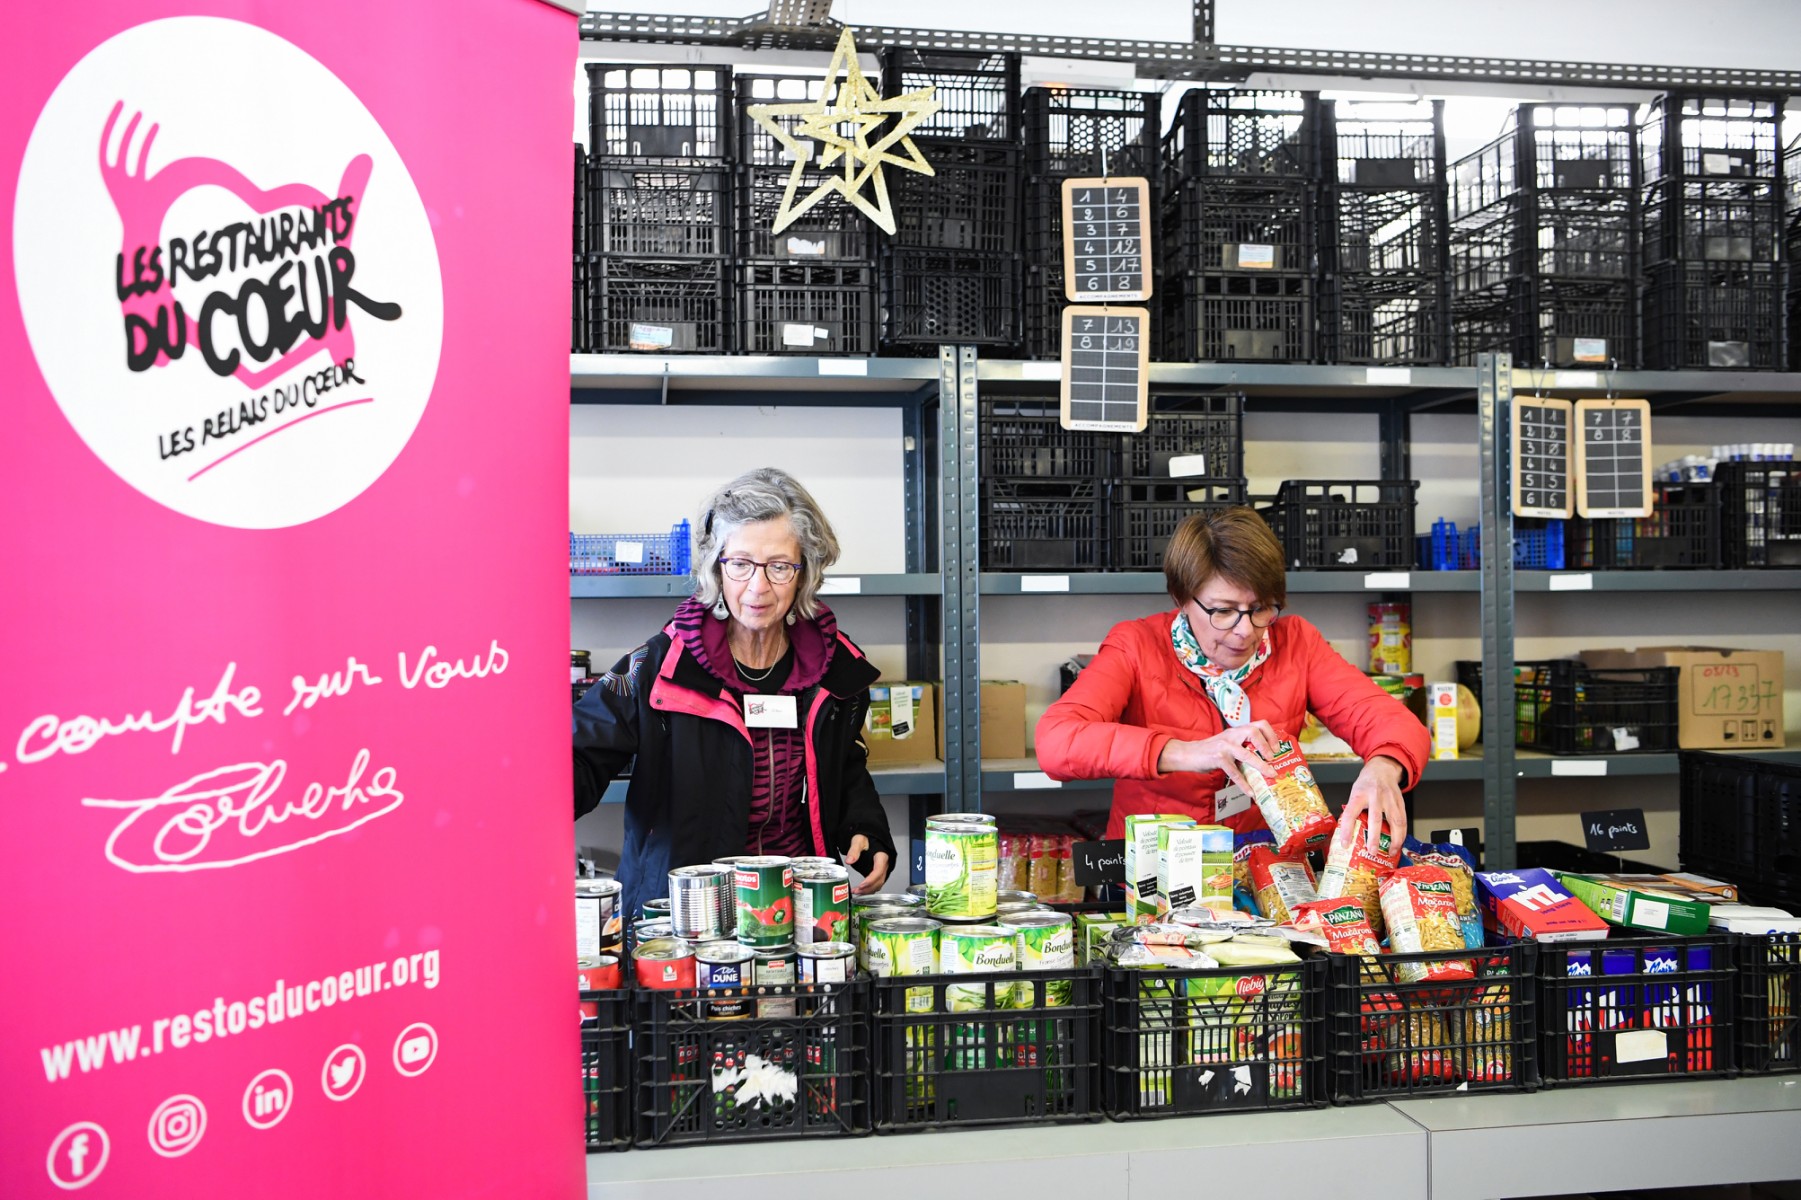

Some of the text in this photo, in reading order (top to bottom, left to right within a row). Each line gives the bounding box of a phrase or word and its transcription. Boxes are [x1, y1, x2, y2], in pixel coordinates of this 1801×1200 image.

[1079, 188, 1127, 204] 1 4
[1084, 203, 1128, 221] 2 6
[1086, 223, 1129, 236] 3 7
[116, 196, 354, 302] LES RESTAURANTS
[1084, 238, 1137, 255] 4 12
[1085, 257, 1140, 273] 5 17
[1087, 275, 1131, 290] 6 8
[1082, 319, 1135, 335] 7 13
[124, 301, 187, 373] DU
[1080, 335, 1135, 351] 8 19
[158, 431, 195, 461] LES
[201, 393, 270, 446] RELAIS
[273, 382, 299, 411] DU
[1527, 442, 1536, 454] 3
[1525, 474, 1535, 486] 5
[1526, 492, 1536, 504] 6
[16, 662, 263, 763] compte
[284, 657, 382, 716] sur
[1589, 823, 1604, 836] 16
[926, 849, 956, 861] onduelle
[1085, 854, 1094, 870] 4
[1328, 907, 1364, 924] PANZANI
[712, 974, 739, 983] DUNE
[40, 949, 440, 1083] www.restosducoeur.org
[254, 1086, 284, 1117] in
